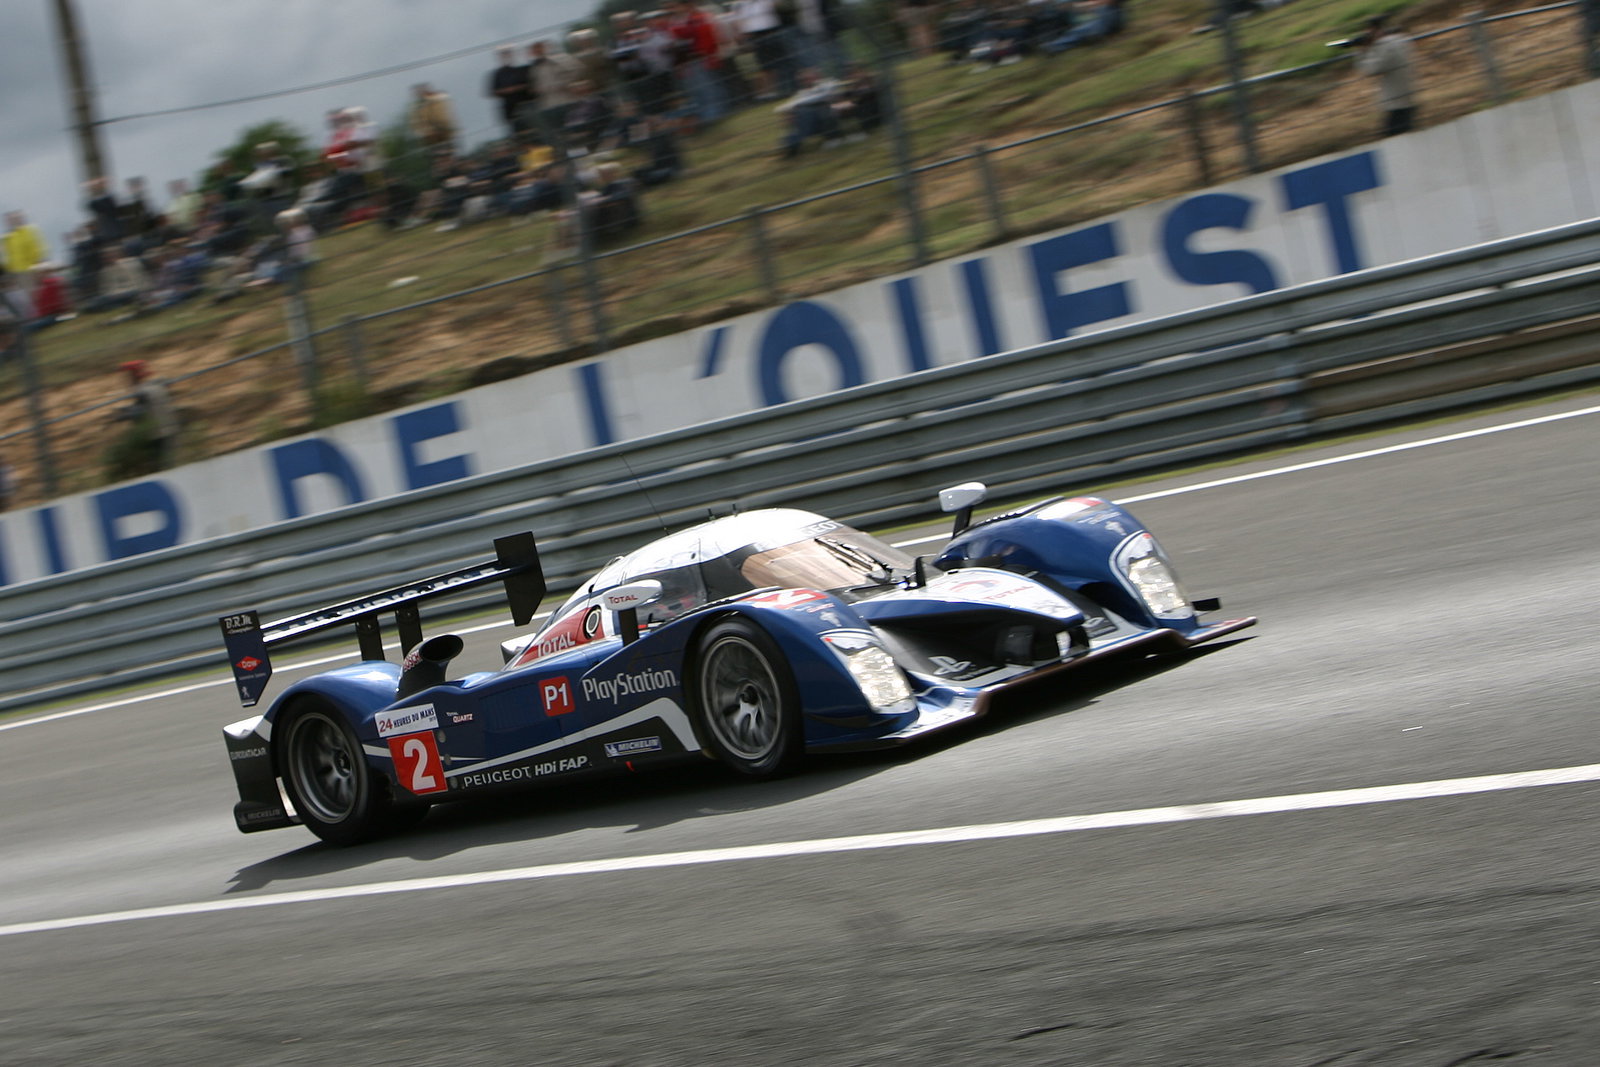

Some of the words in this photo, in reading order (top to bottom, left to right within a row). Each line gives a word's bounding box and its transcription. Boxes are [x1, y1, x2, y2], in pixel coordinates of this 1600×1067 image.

[608, 594, 639, 605] TOTAL
[535, 632, 576, 657] TOTAL
[544, 683, 571, 710] P1
[582, 668, 677, 704] PlayStation
[379, 718, 394, 733] 24
[393, 715, 412, 728] HEURES
[412, 712, 421, 722] DU
[420, 707, 436, 720] MANS
[452, 713, 474, 724] QUARTZ
[618, 739, 659, 751] MICHELIN
[403, 738, 437, 791] 2
[463, 765, 531, 788] PEUGEOT
[559, 756, 589, 771] FAP
